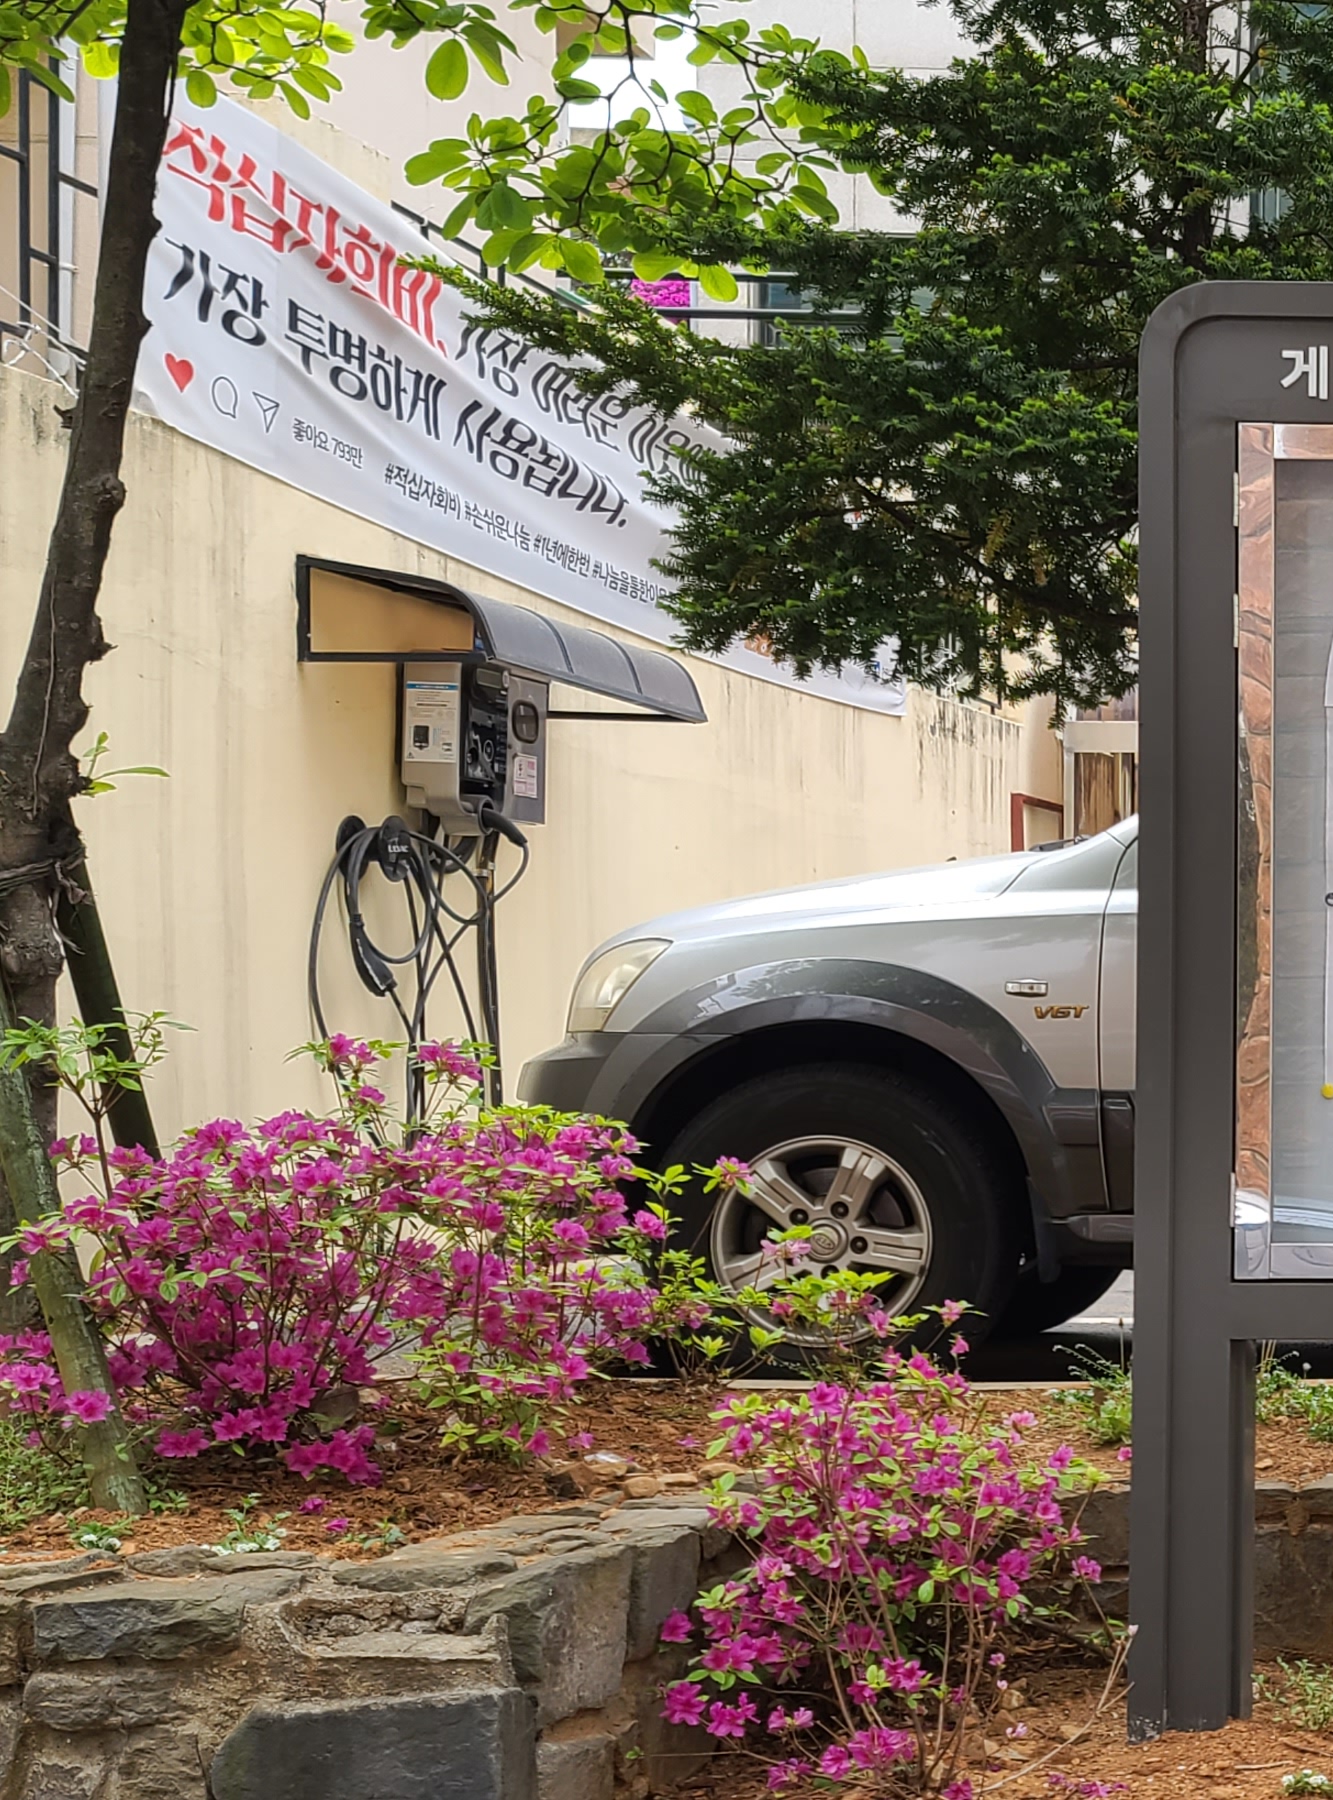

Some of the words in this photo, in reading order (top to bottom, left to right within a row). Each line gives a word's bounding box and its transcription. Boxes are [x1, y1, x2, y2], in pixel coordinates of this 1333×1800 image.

[163, 237, 269, 346] 가장
[284, 298, 446, 441] 투명하게
[453, 399, 629, 528] 사용됩니다.
[292, 417, 330, 453] 좋아요
[331, 436, 364, 470] 793만
[384, 462, 461, 520] #적십자회비
[464, 501, 531, 554] #손쉬운나눔
[533, 532, 591, 579] #1년에한번
